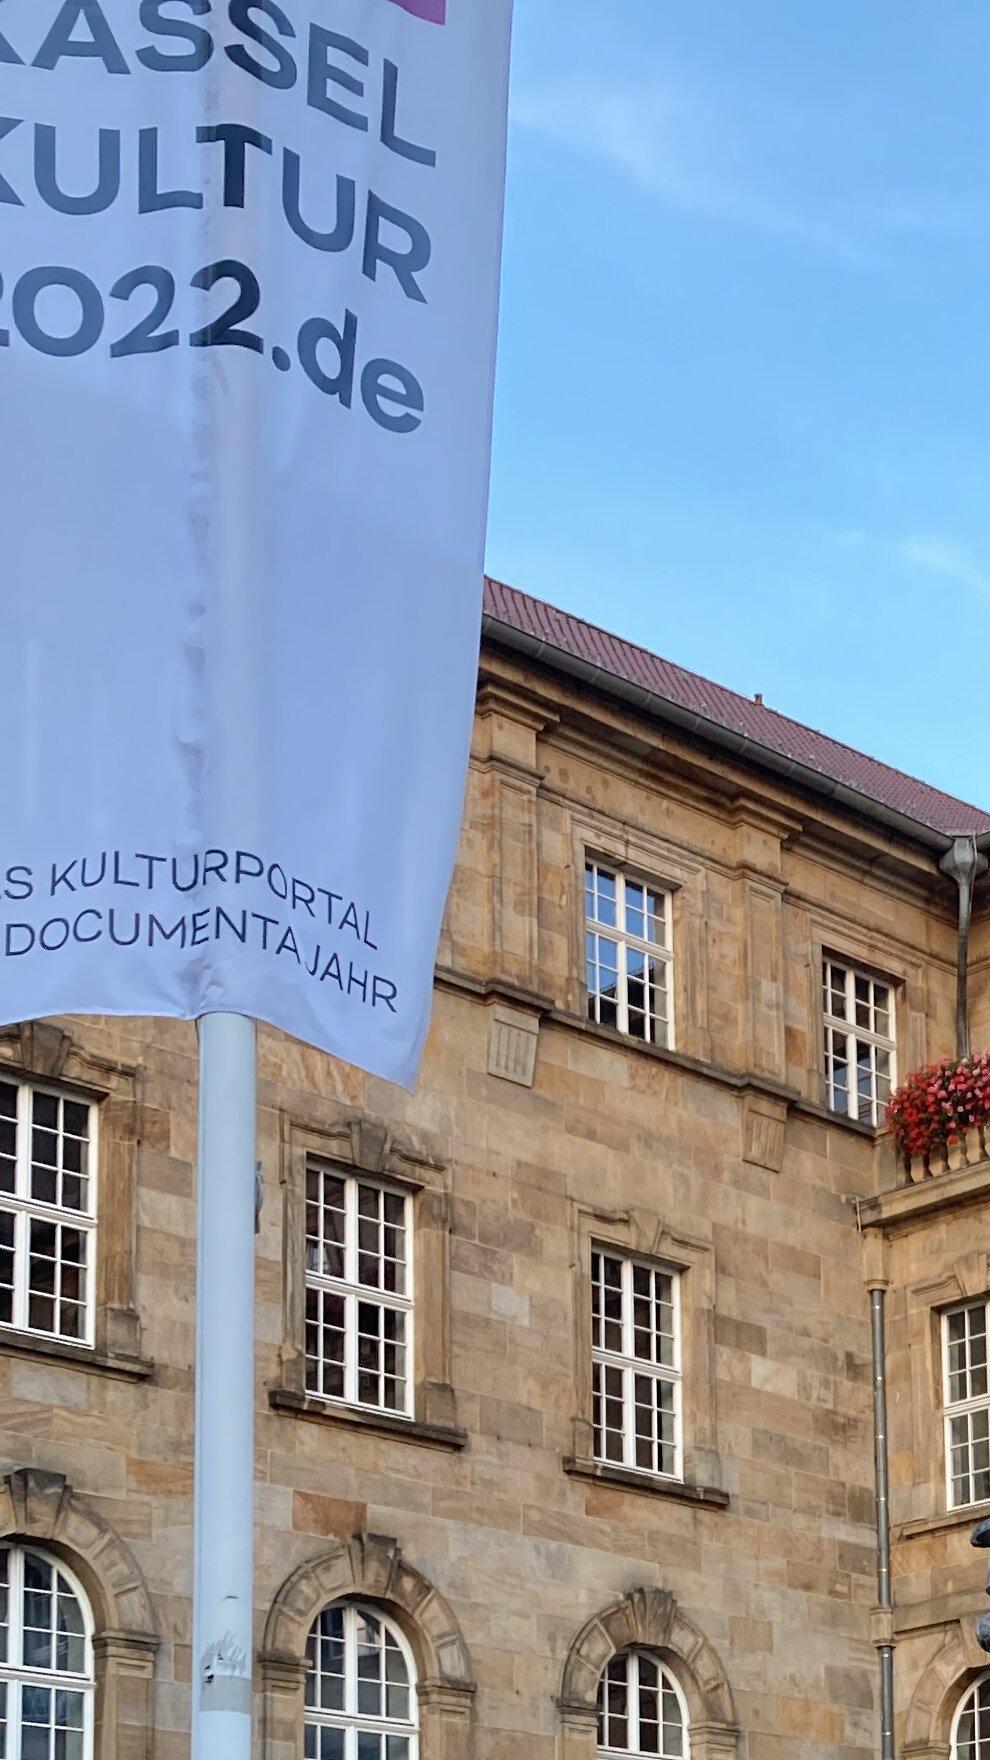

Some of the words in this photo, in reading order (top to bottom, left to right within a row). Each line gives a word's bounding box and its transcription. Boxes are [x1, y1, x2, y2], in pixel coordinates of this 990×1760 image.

[0, 0, 437, 168] ASSEL
[0, 258, 425, 434] 022.de
[50, 848, 378, 951] KULTURPORTAL
